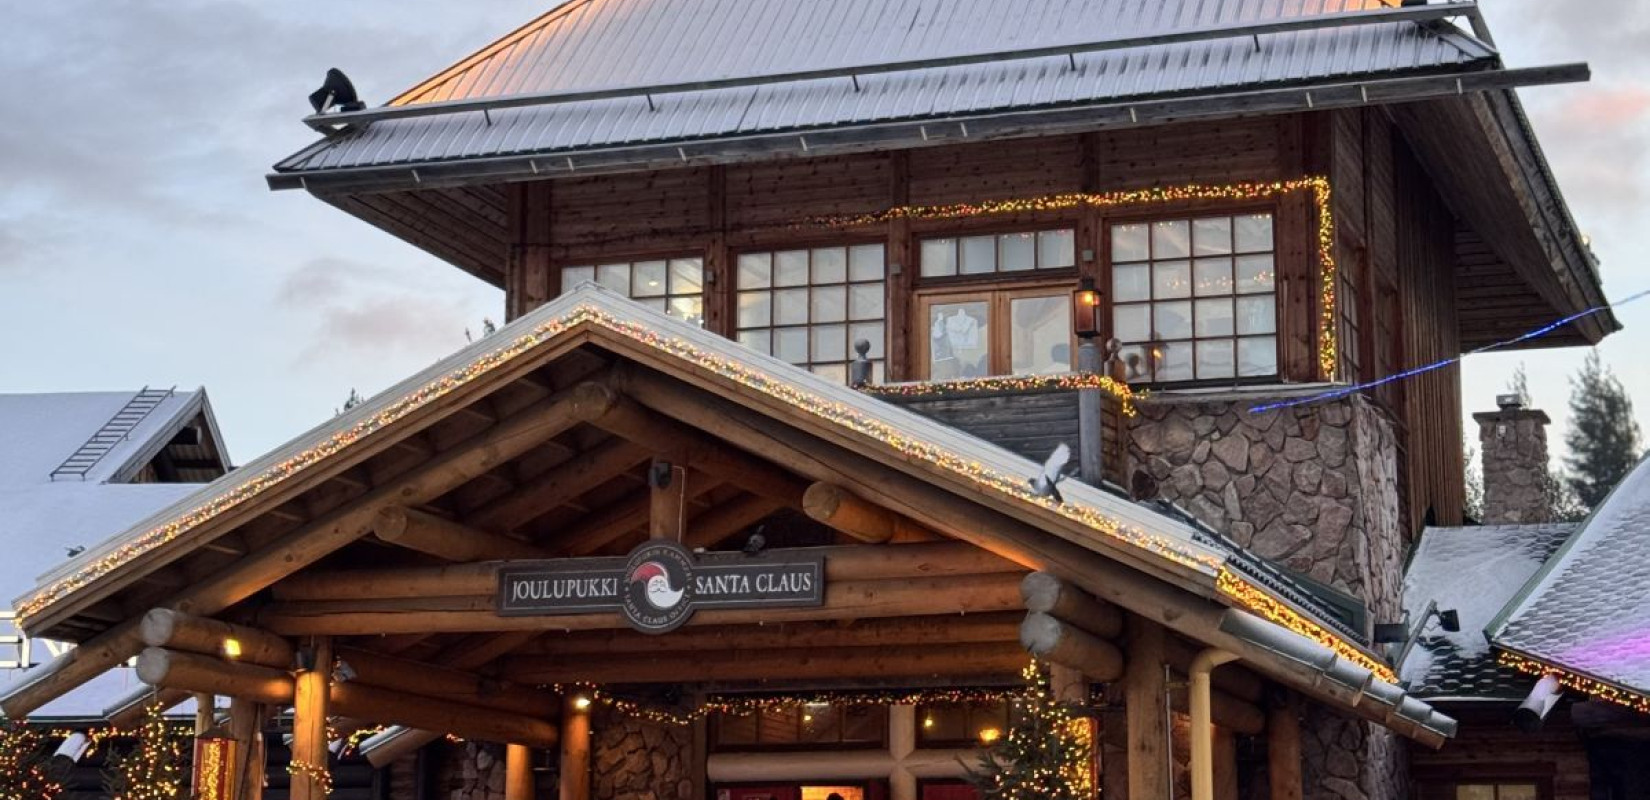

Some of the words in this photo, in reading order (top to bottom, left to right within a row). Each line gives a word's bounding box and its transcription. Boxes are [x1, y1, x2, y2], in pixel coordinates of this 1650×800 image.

[512, 578, 618, 602] JOULUPUKKI
[695, 574, 751, 595] SANTA
[755, 572, 811, 592] CLAUS
